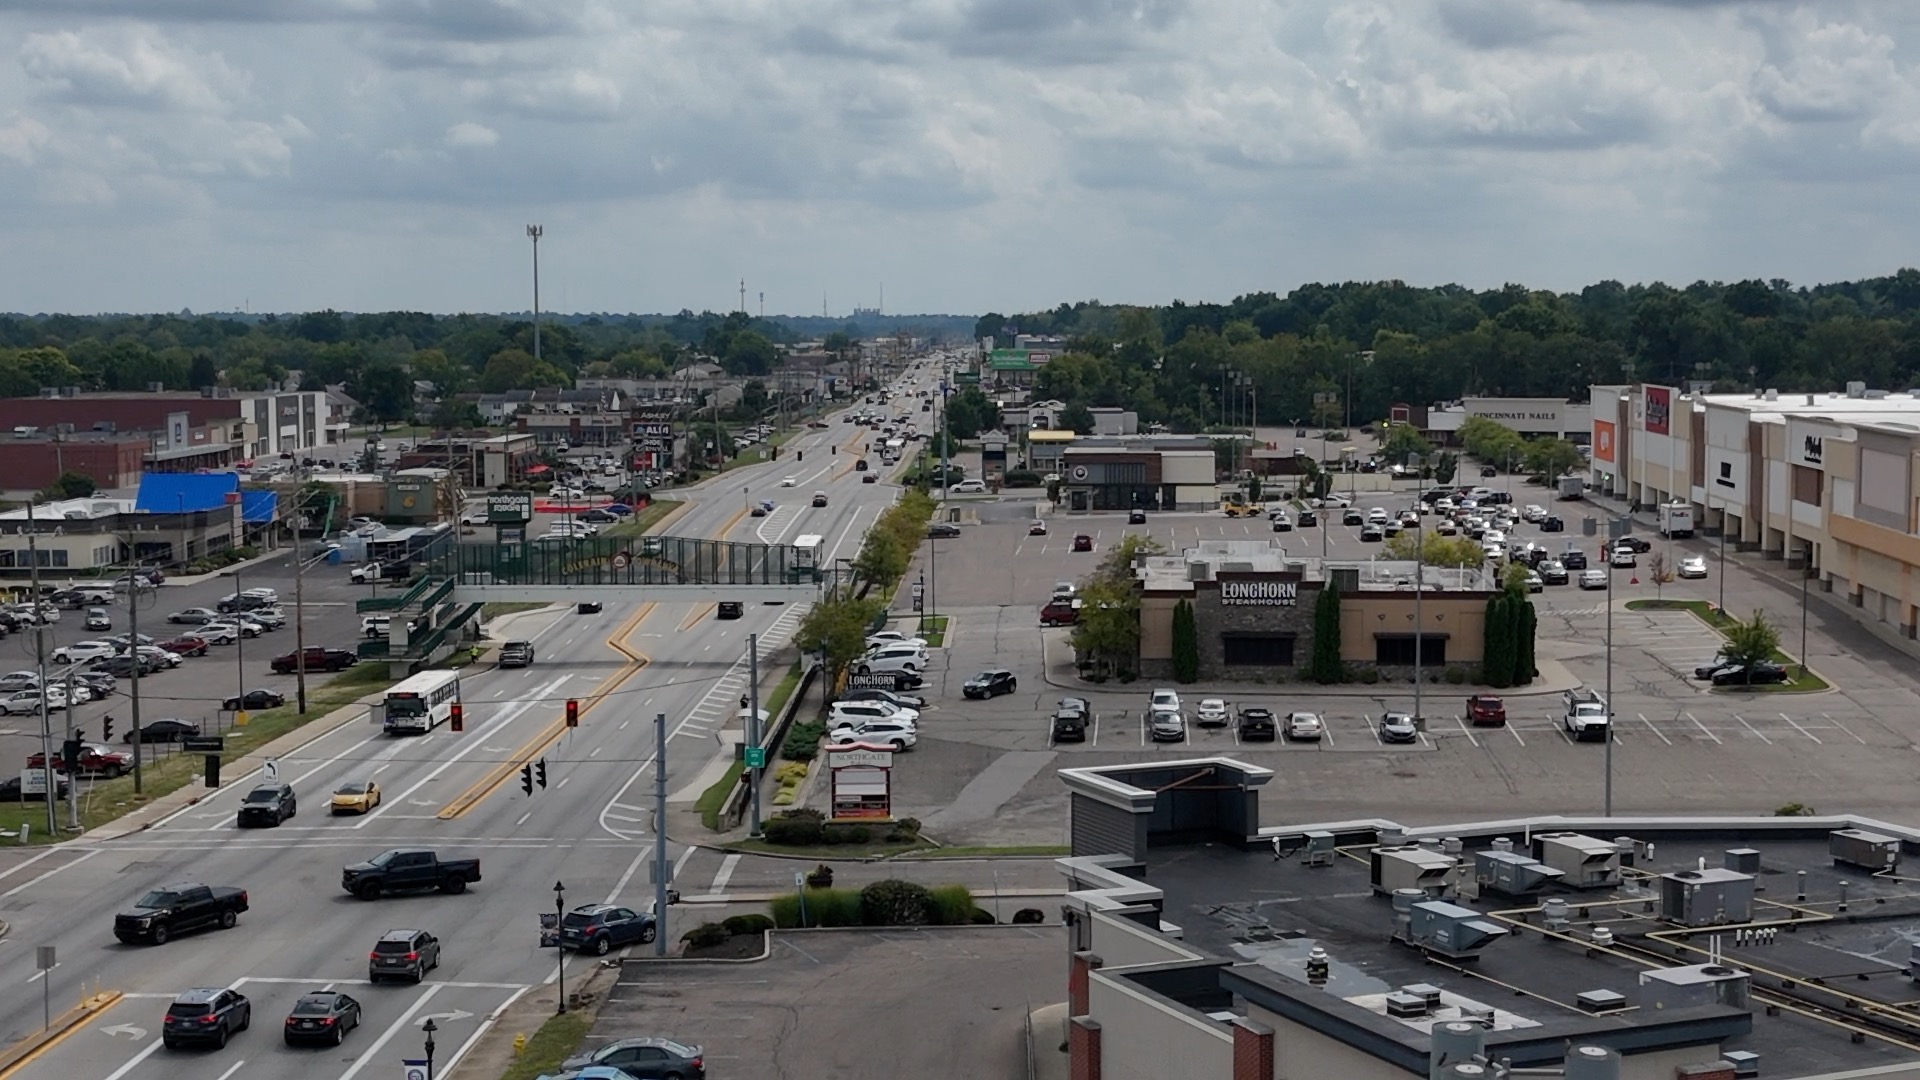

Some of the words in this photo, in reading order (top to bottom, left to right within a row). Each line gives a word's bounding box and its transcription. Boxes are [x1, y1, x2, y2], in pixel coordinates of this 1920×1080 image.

[1473, 412, 1525, 420] CINCINNATI
[1529, 412, 1556, 420] NAILS
[1222, 582, 1297, 598] LONGHORN
[848, 674, 896, 686] LONGHORN
